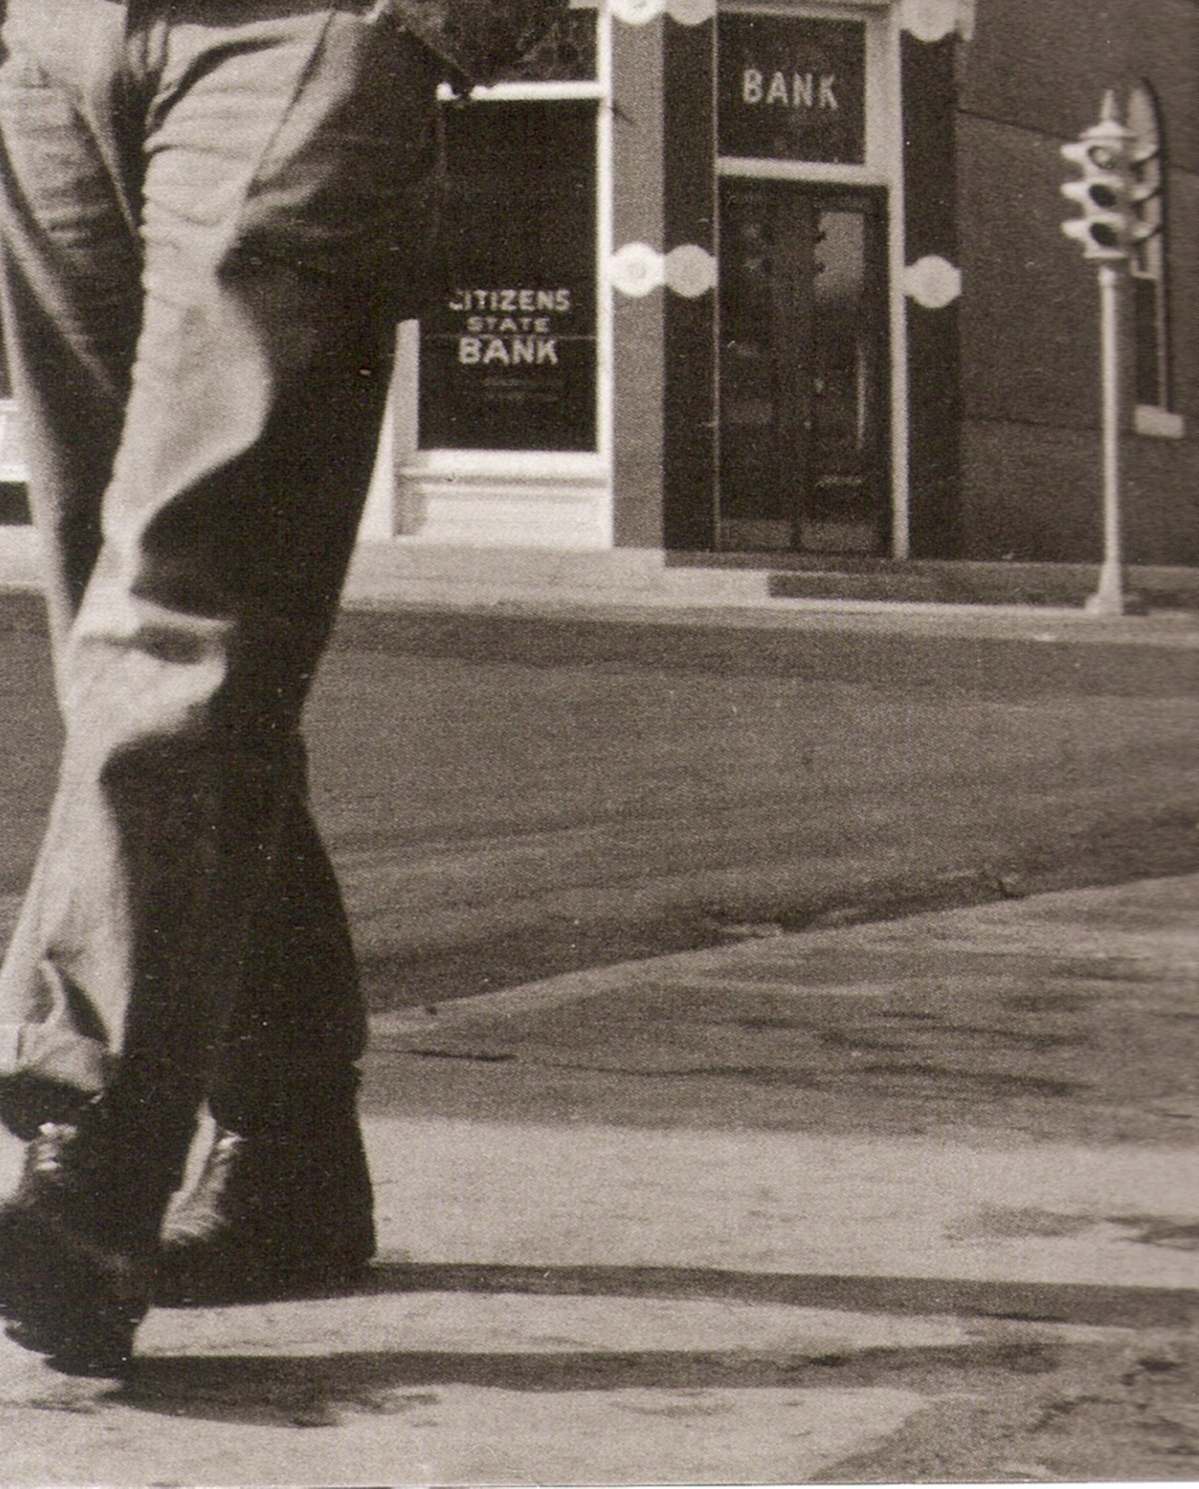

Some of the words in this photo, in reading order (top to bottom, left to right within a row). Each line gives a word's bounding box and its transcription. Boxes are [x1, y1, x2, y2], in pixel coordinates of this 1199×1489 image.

[742, 68, 840, 110] BANK
[466, 316, 551, 333] STATE
[458, 337, 559, 365] BANK
